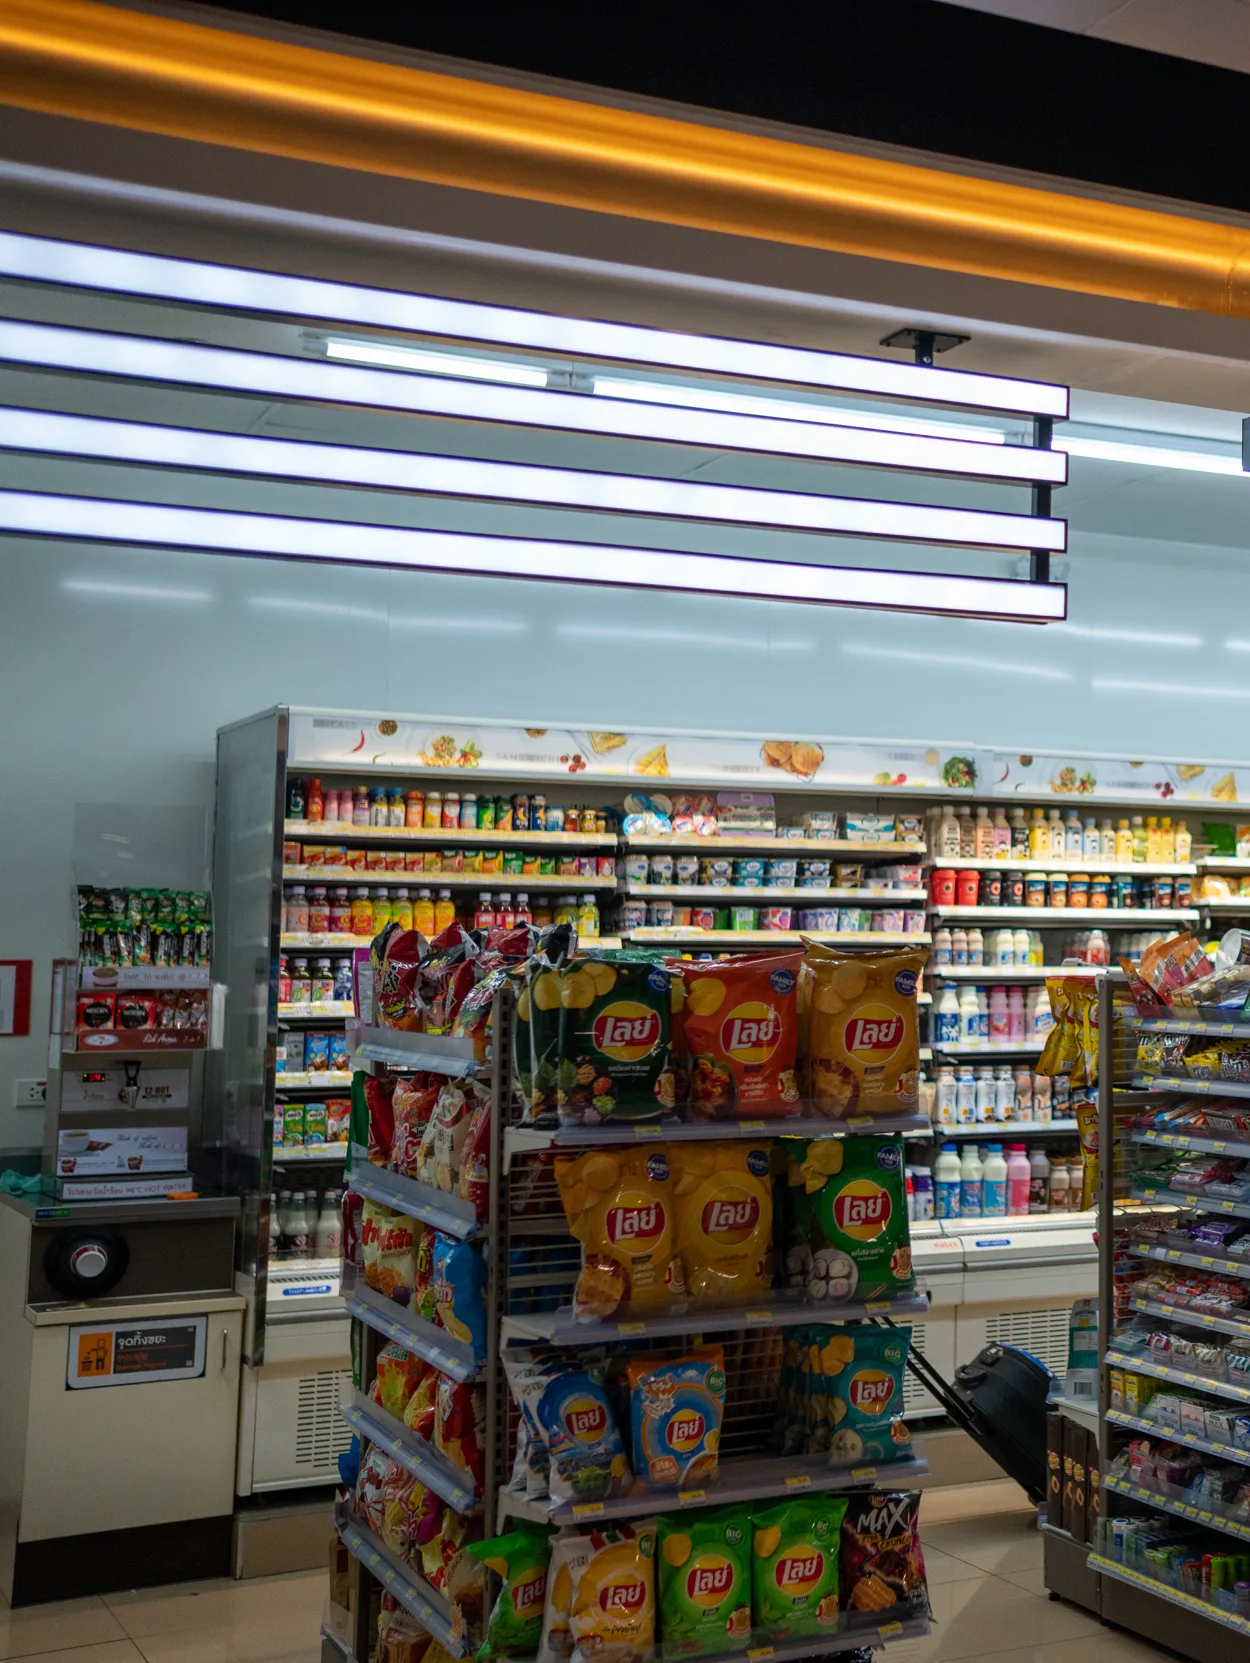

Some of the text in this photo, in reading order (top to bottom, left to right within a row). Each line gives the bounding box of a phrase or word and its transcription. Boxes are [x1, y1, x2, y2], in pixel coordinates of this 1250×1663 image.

[602, 1014, 651, 1047] เลย์
[730, 1013, 776, 1049] เลย์
[853, 1016, 897, 1048] เลย์
[842, 1188, 883, 1226] เลย์
[117, 1331, 167, 1350] จุดทิ้งขยะ
[856, 1377, 889, 1404] เลย์
[857, 1497, 911, 1539] MAX
[691, 1563, 730, 1593] เลย์
[781, 1555, 818, 1585] เลย์
[604, 1583, 644, 1611] เลย์
